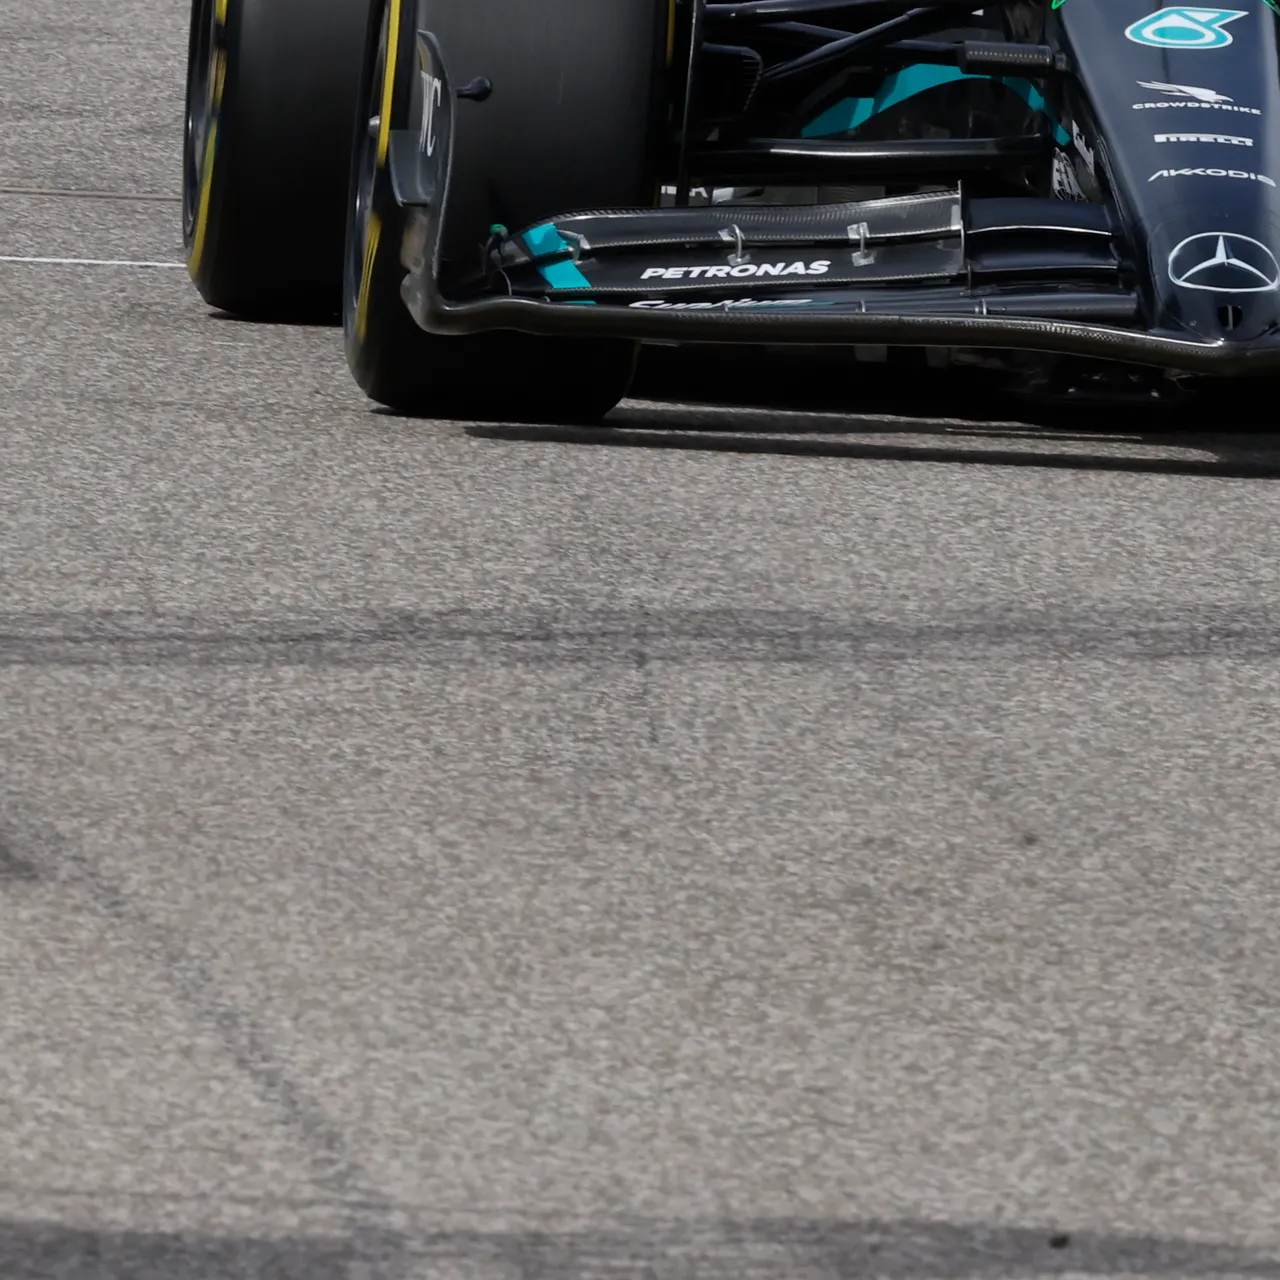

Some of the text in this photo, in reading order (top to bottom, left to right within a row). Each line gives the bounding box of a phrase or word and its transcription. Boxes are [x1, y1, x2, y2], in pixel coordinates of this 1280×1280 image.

[1132, 101, 1262, 116] CROWDSTRIKE
[1153, 132, 1254, 147] PIRELLI
[1147, 167, 1277, 187] AKKODIS
[640, 260, 831, 279] PETRONAS
